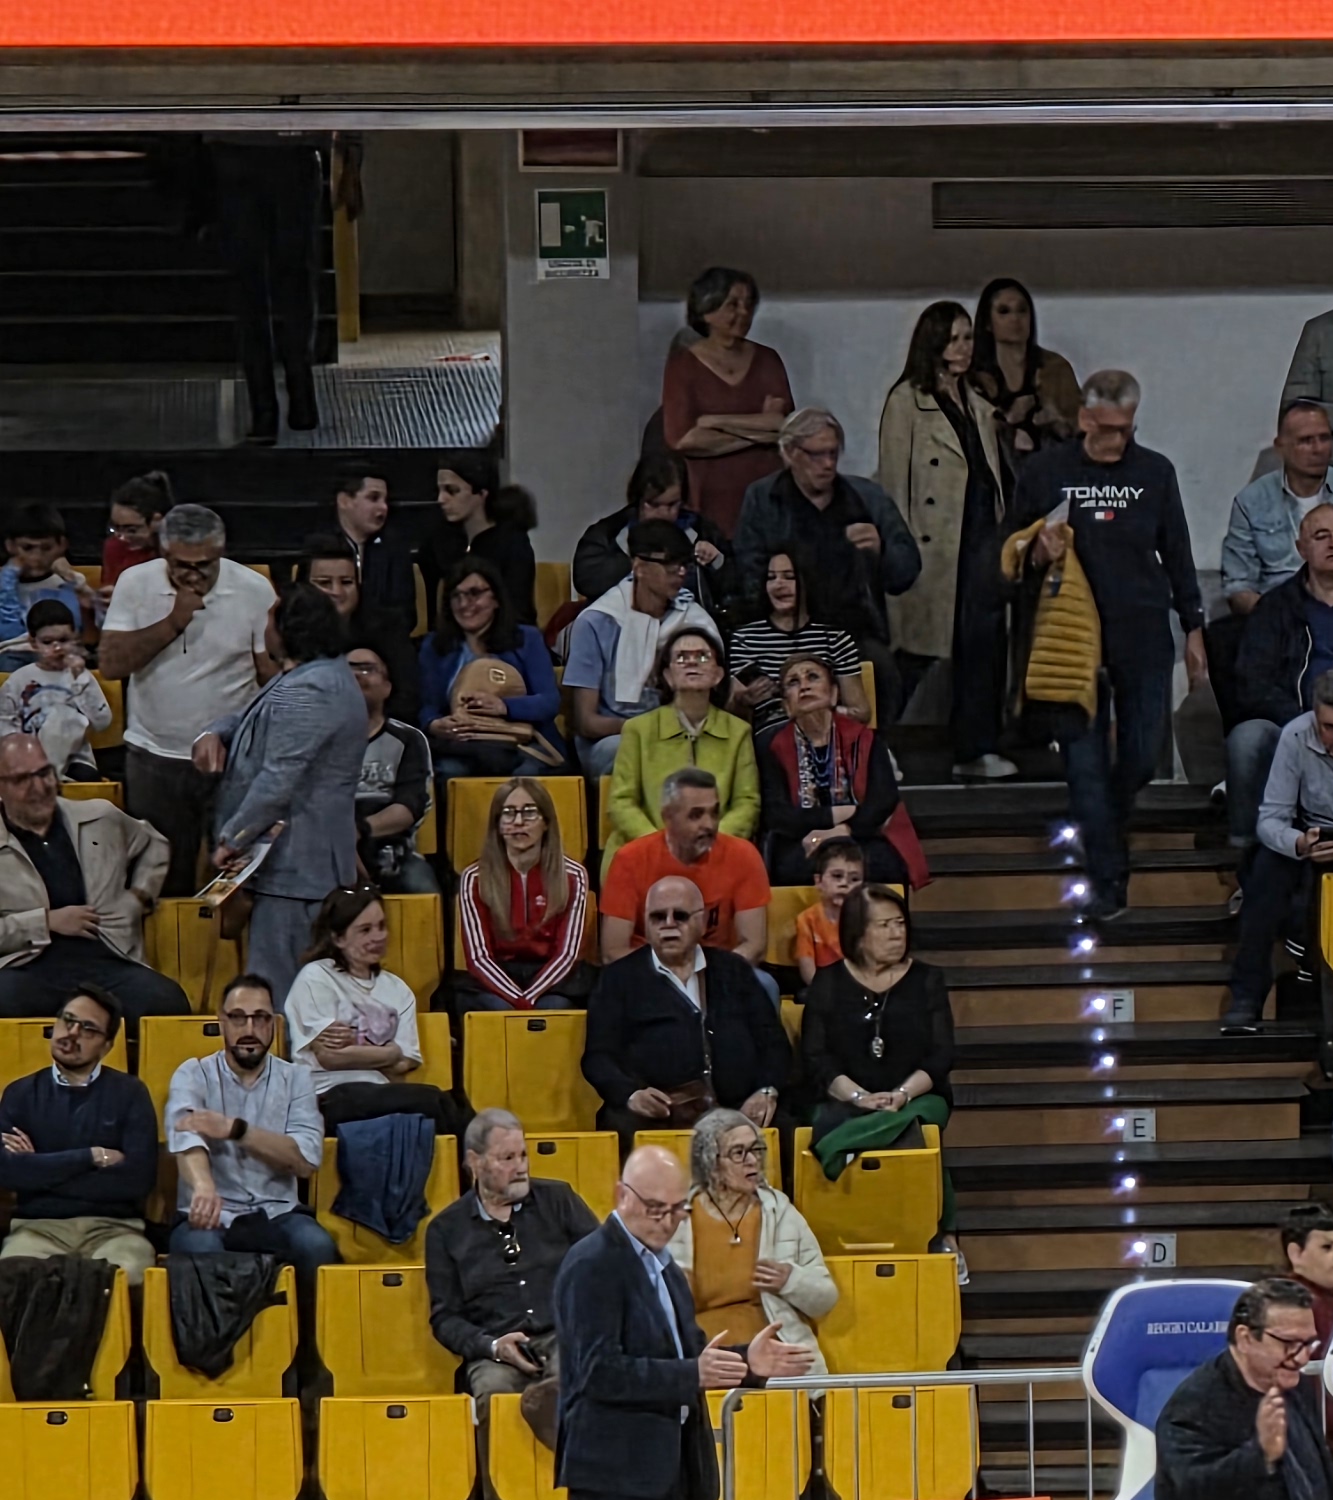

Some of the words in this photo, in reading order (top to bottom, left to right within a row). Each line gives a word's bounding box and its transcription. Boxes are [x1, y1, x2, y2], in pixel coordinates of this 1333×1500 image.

[1061, 485, 1144, 500] TOMMY
[1112, 998, 1125, 1018] F
[1133, 1117, 1147, 1138] E
[1152, 1242, 1167, 1263] D
